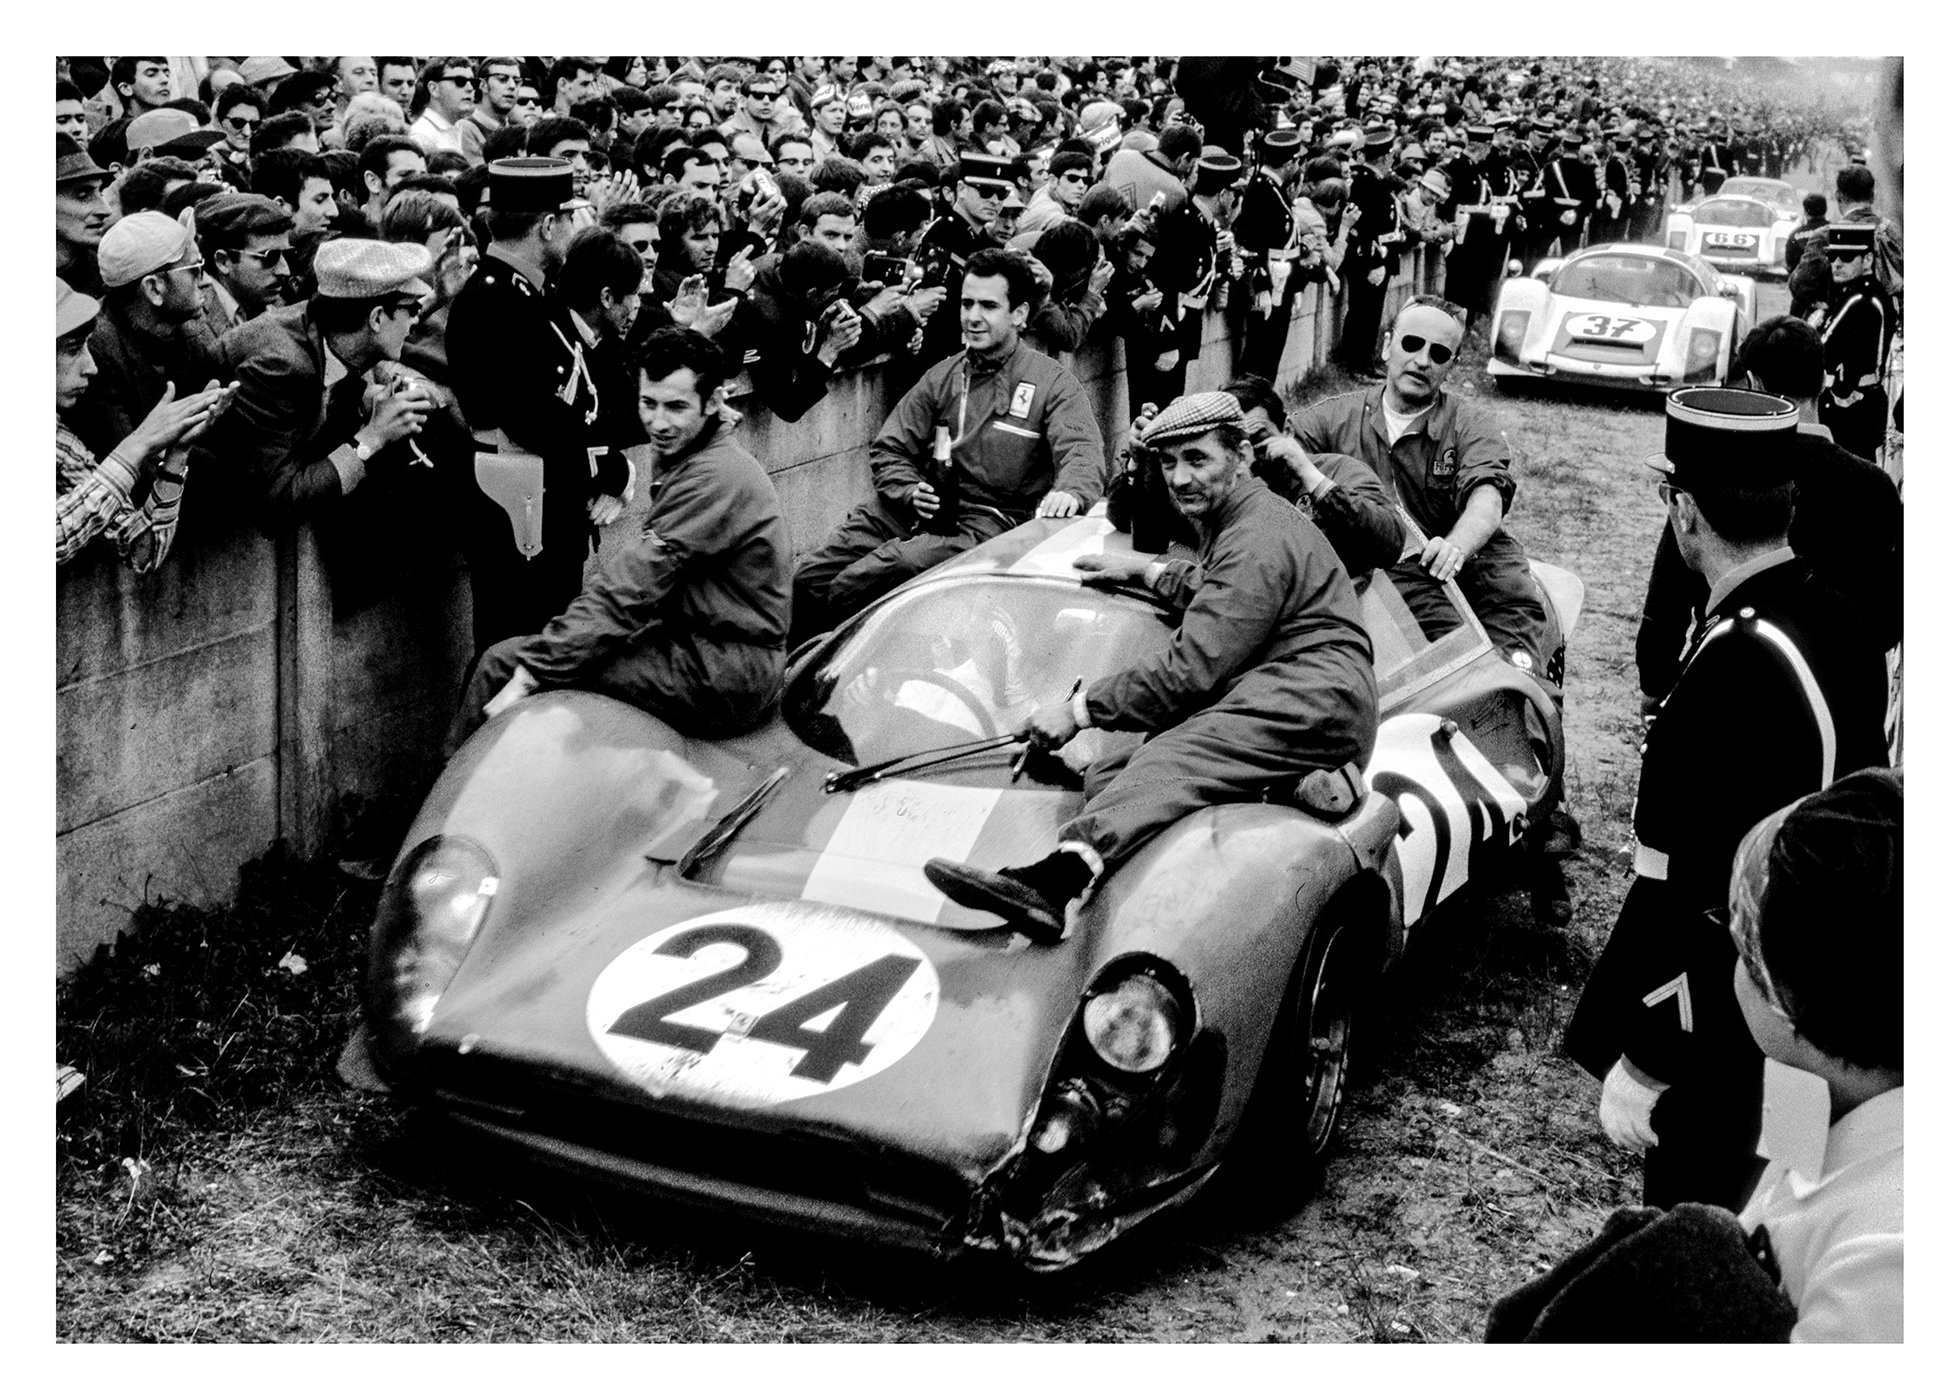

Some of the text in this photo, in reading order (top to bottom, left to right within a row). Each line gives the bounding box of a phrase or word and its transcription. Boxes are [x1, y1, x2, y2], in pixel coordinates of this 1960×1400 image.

[1714, 232, 1747, 246] 66
[1583, 315, 1641, 337] 37
[605, 922, 923, 1085] 24
